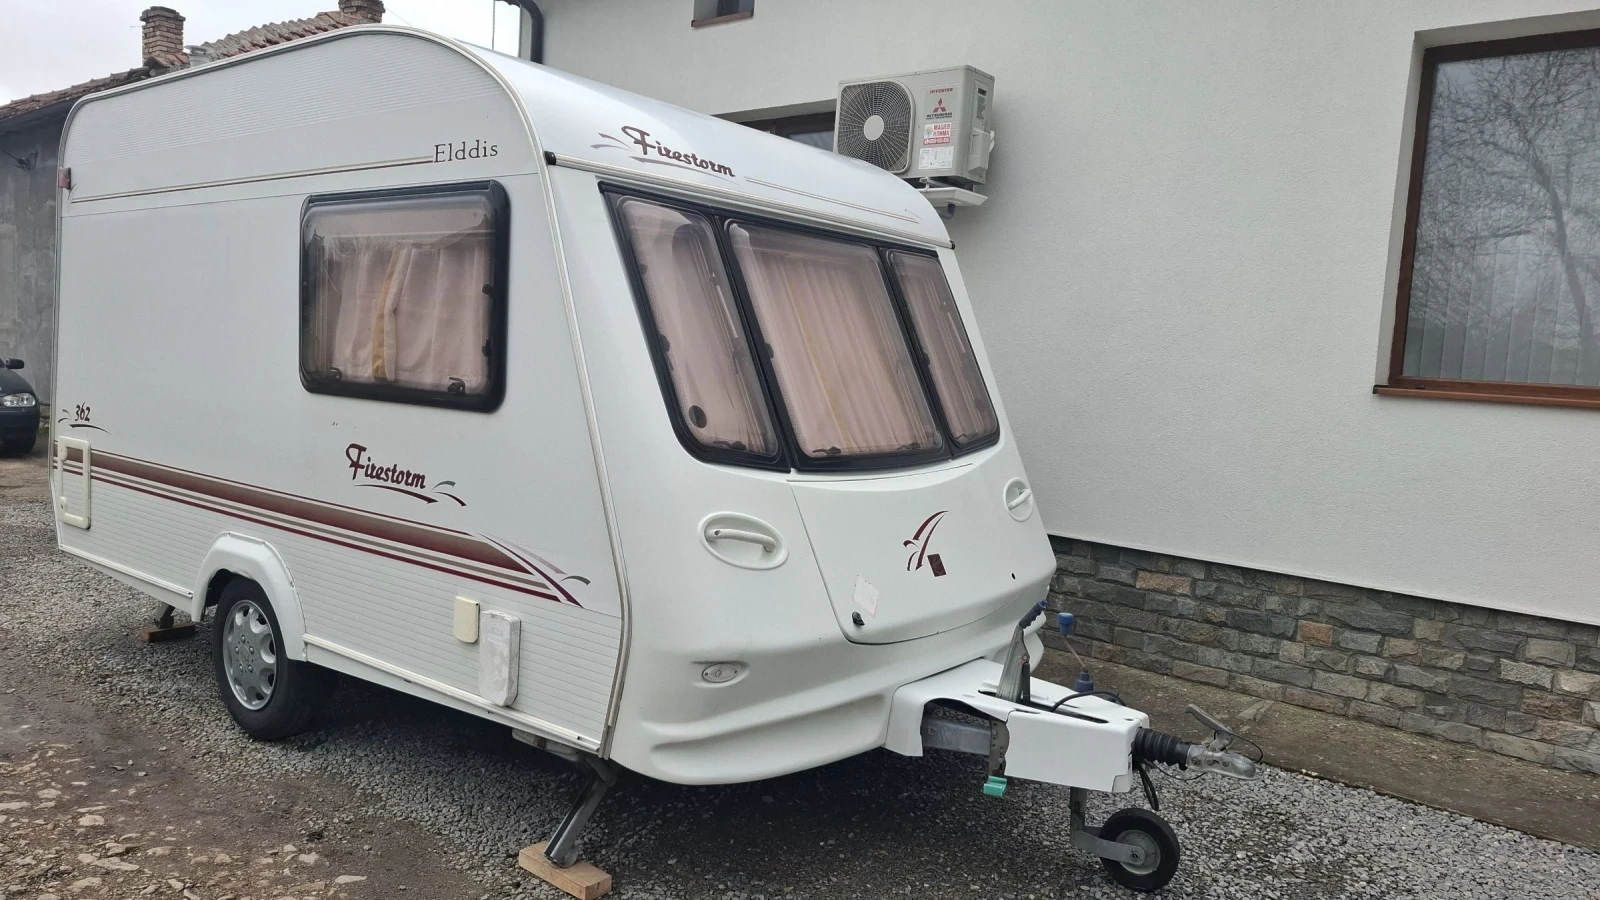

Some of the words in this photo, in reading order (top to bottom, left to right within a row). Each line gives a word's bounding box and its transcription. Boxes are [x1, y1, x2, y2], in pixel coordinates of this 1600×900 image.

[434, 140, 498, 163] Elddis
[621, 125, 736, 178] Firestorm
[74, 402, 91, 422] 362
[345, 443, 426, 489] Firestorm
